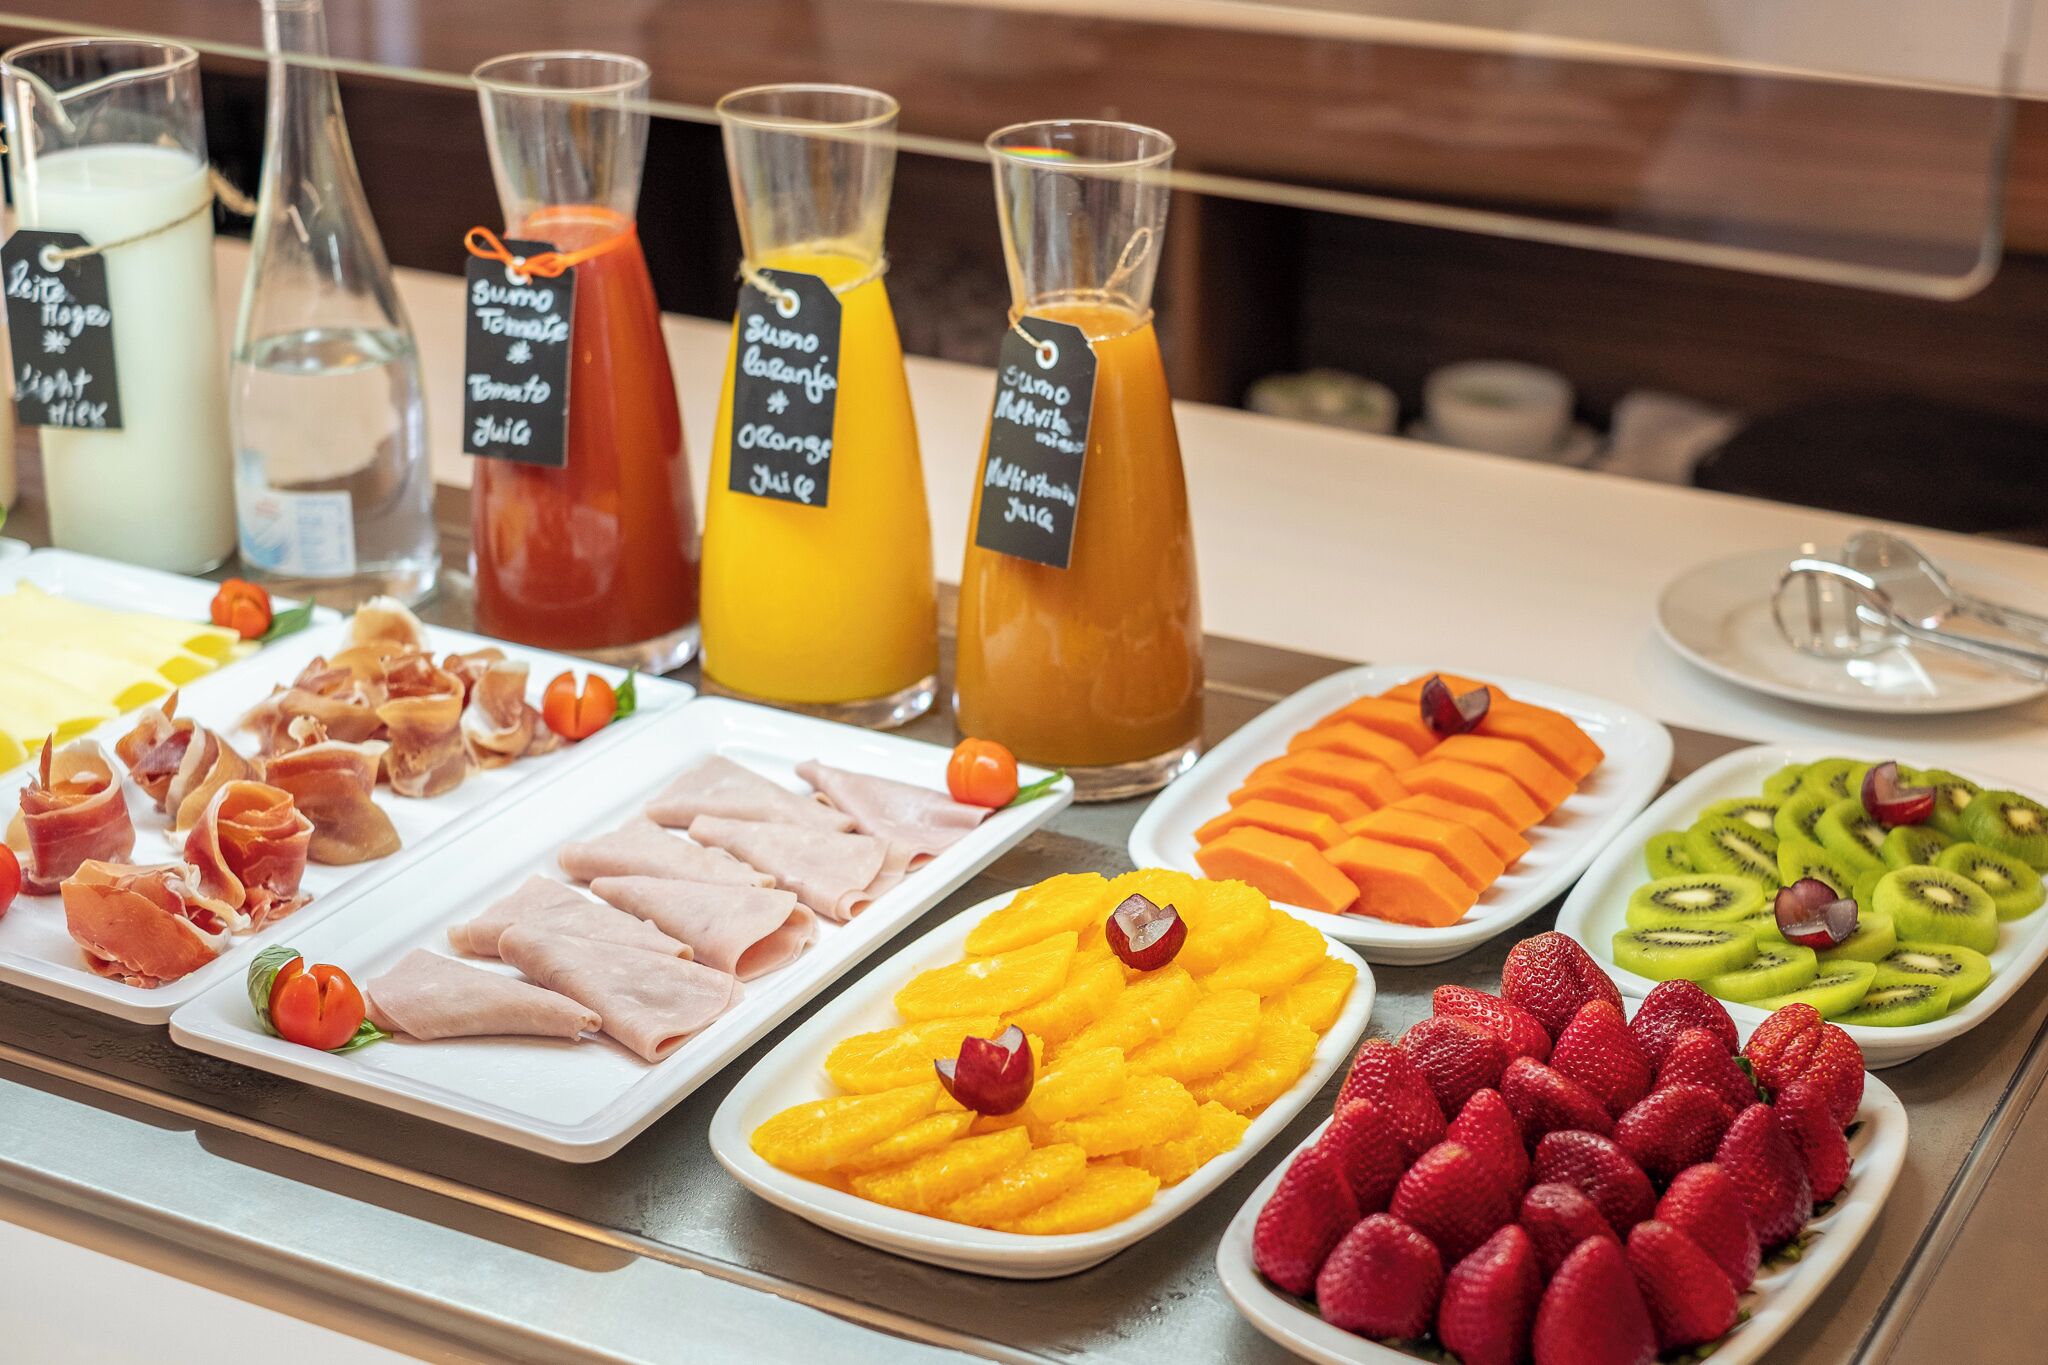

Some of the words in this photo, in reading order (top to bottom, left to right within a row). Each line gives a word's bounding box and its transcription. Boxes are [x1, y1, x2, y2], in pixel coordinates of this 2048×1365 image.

[472, 278, 554, 313] Sumo
[475, 307, 569, 344] Tomate
[745, 314, 819, 353] Sumo
[467, 373, 551, 404] Tomato
